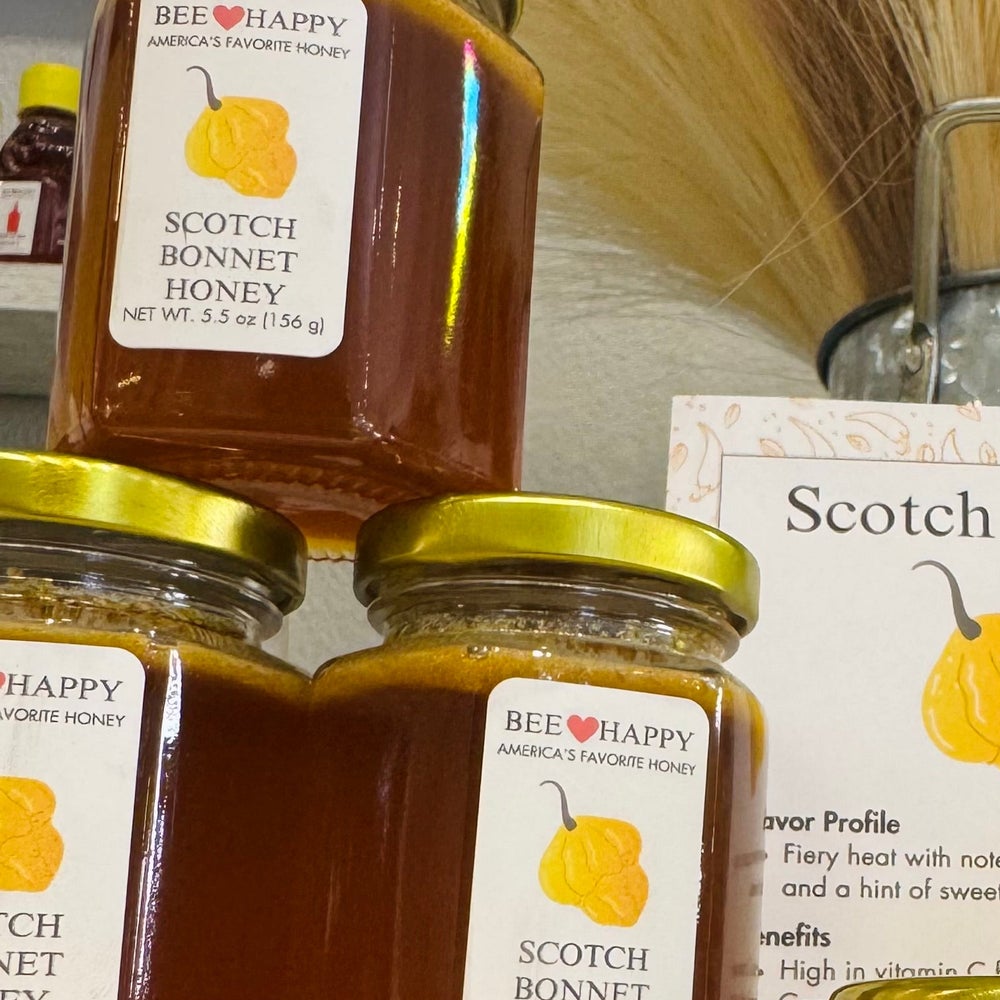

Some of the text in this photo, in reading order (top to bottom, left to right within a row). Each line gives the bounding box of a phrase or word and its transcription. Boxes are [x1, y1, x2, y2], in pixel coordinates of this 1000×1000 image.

[155, 5, 348, 37] BEE HAPPY
[147, 35, 350, 60] AMERICA'S FAVORITE HONEY
[164, 211, 297, 240] SCOTCH
[159, 244, 299, 273] BONNET
[165, 278, 286, 305] HONEY
[123, 307, 325, 336] NET WT. 5.5 oz (156 g)
[786, 485, 996, 540] Scotch
[5, 673, 124, 702] HAPPY
[0, 707, 126, 728] VORITE HONEY
[505, 710, 695, 752] BEE HAPPY
[497, 742, 697, 776] AMERICA'S FAVORITE HONEY
[763, 809, 900, 834] avor Profile
[783, 842, 839, 872] Fiery
[848, 843, 897, 867] heat
[905, 845, 951, 868] with
[782, 875, 827, 898] and
[835, 884, 851, 899] a
[860, 876, 902, 899] hint
[909, 877, 933, 900] of
[760, 922, 831, 947] nefits
[517, 940, 650, 971] SCOTCH
[781, 958, 836, 986] High
[846, 961, 866, 981] in
